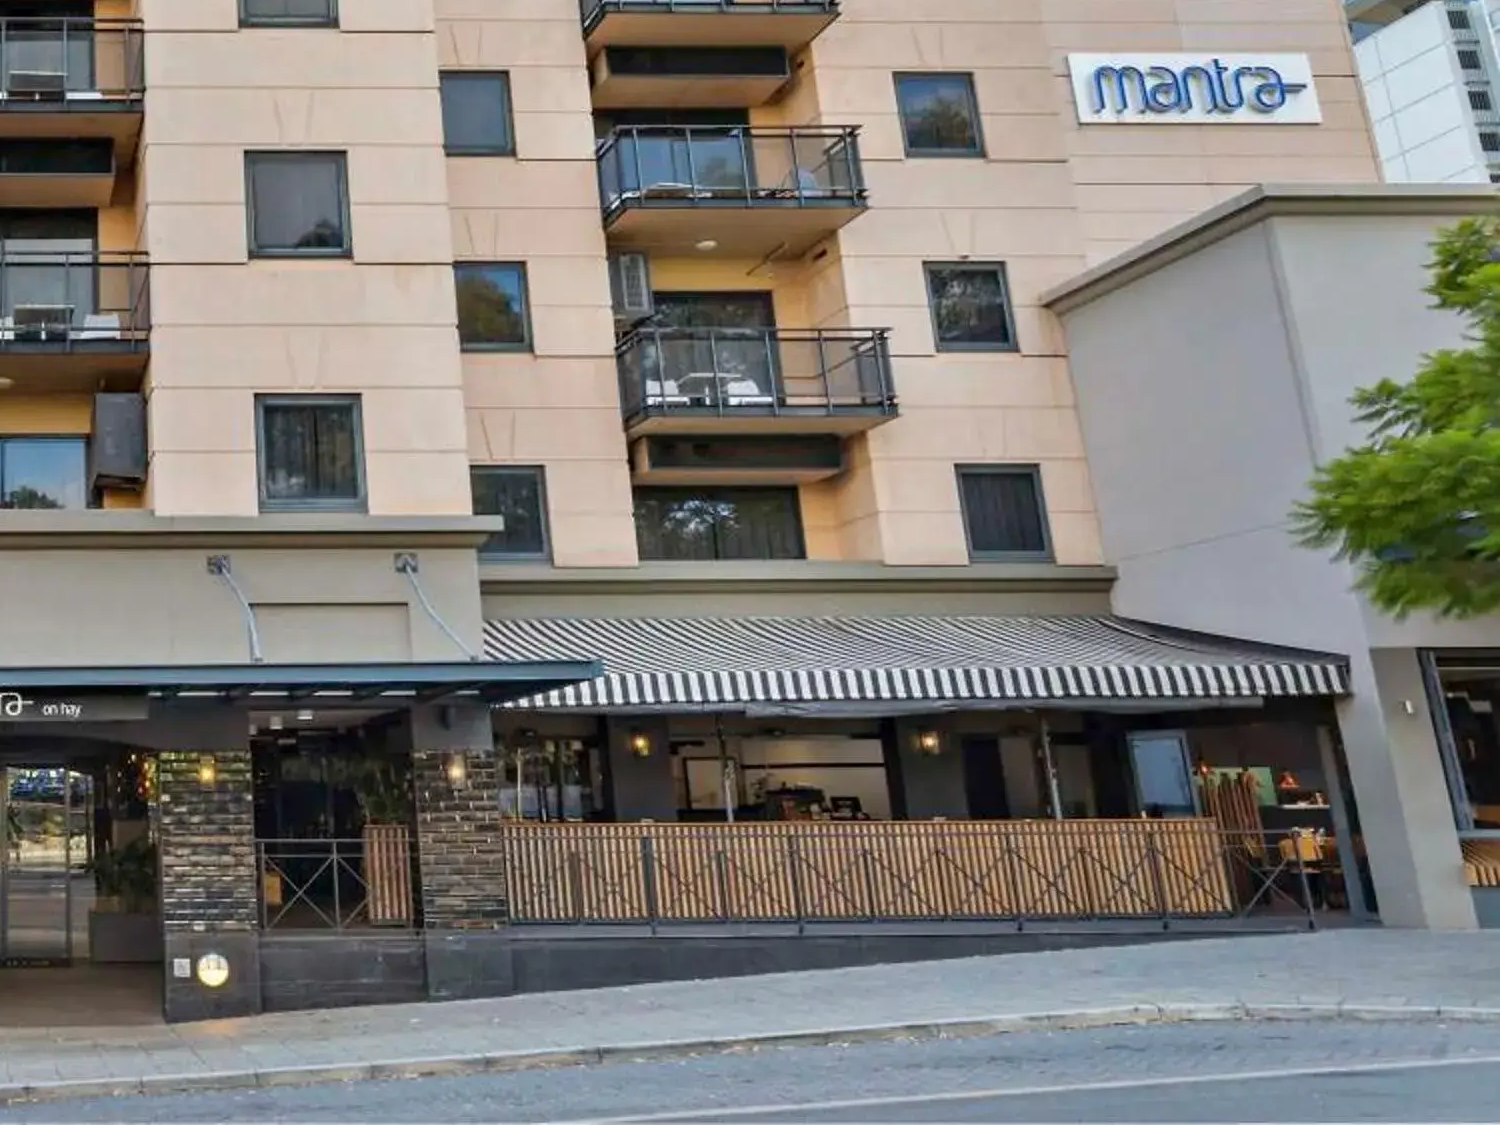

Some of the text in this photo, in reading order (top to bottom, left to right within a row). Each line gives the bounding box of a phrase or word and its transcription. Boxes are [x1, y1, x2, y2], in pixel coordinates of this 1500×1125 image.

[1092, 58, 1307, 114] mantra
[43, 704, 59, 716] on
[61, 702, 82, 718] hay
